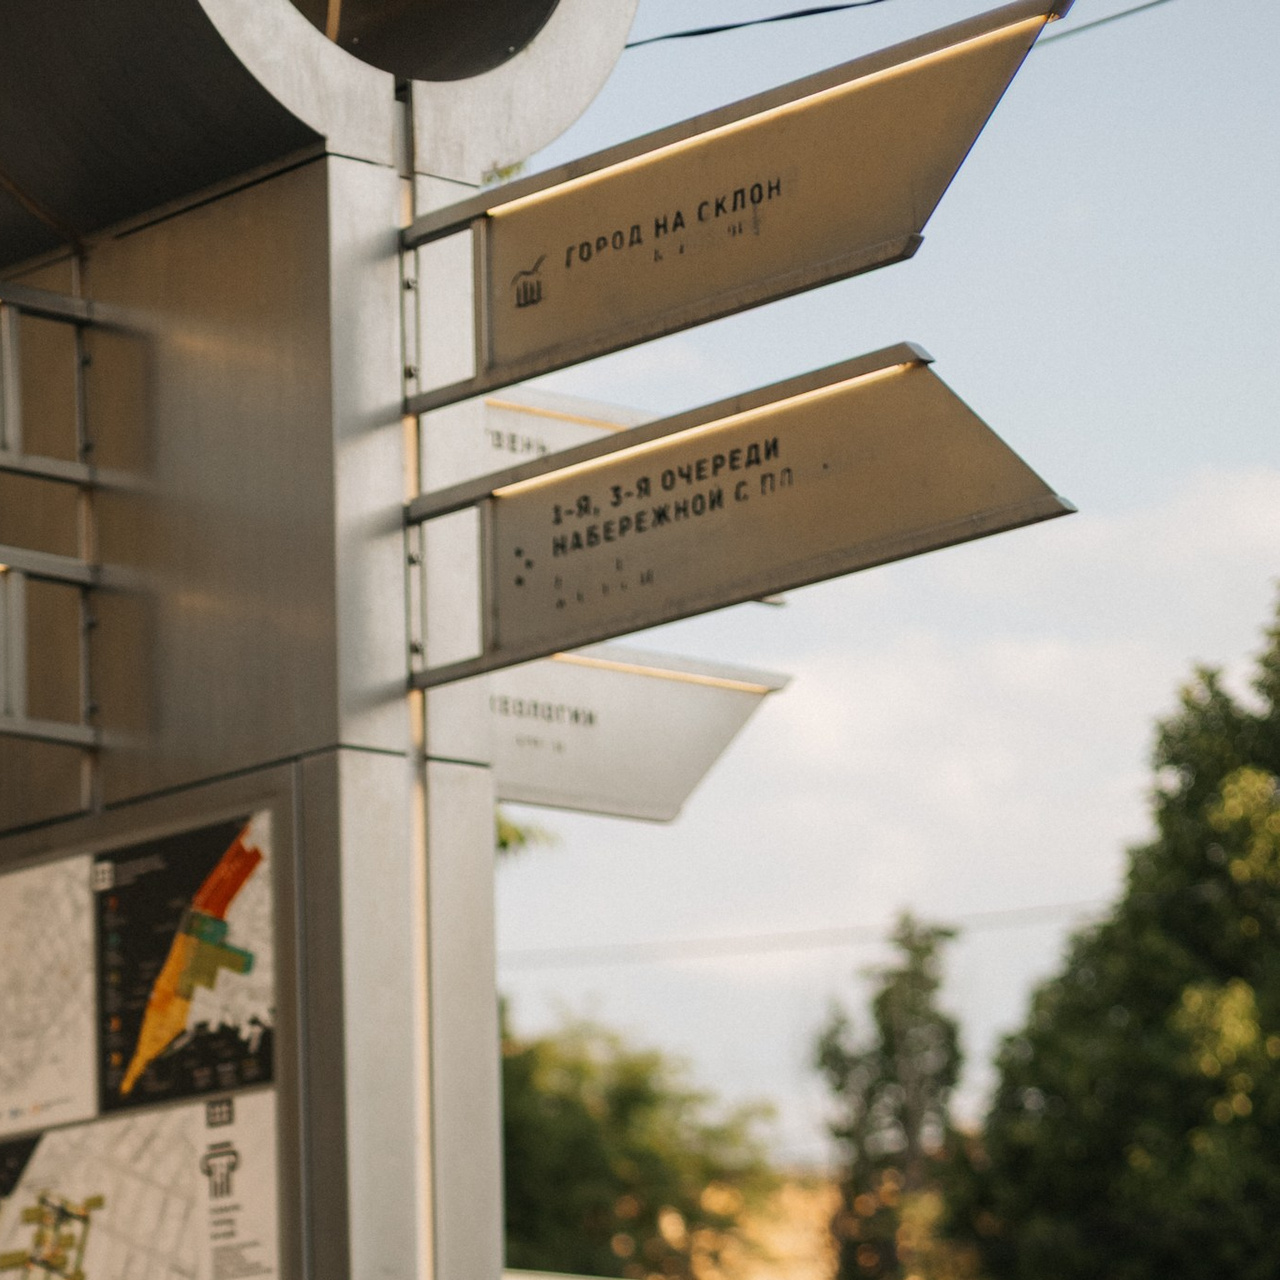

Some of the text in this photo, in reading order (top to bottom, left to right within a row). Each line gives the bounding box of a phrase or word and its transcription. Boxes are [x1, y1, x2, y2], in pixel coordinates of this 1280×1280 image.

[565, 225, 643, 268] ГОРОД
[653, 210, 686, 239] НА
[609, 476, 651, 509] 3-Я
[661, 437, 780, 491] ОЧЕРЕДИ
[552, 488, 725, 557] НАБЕРЕЖНОЙ
